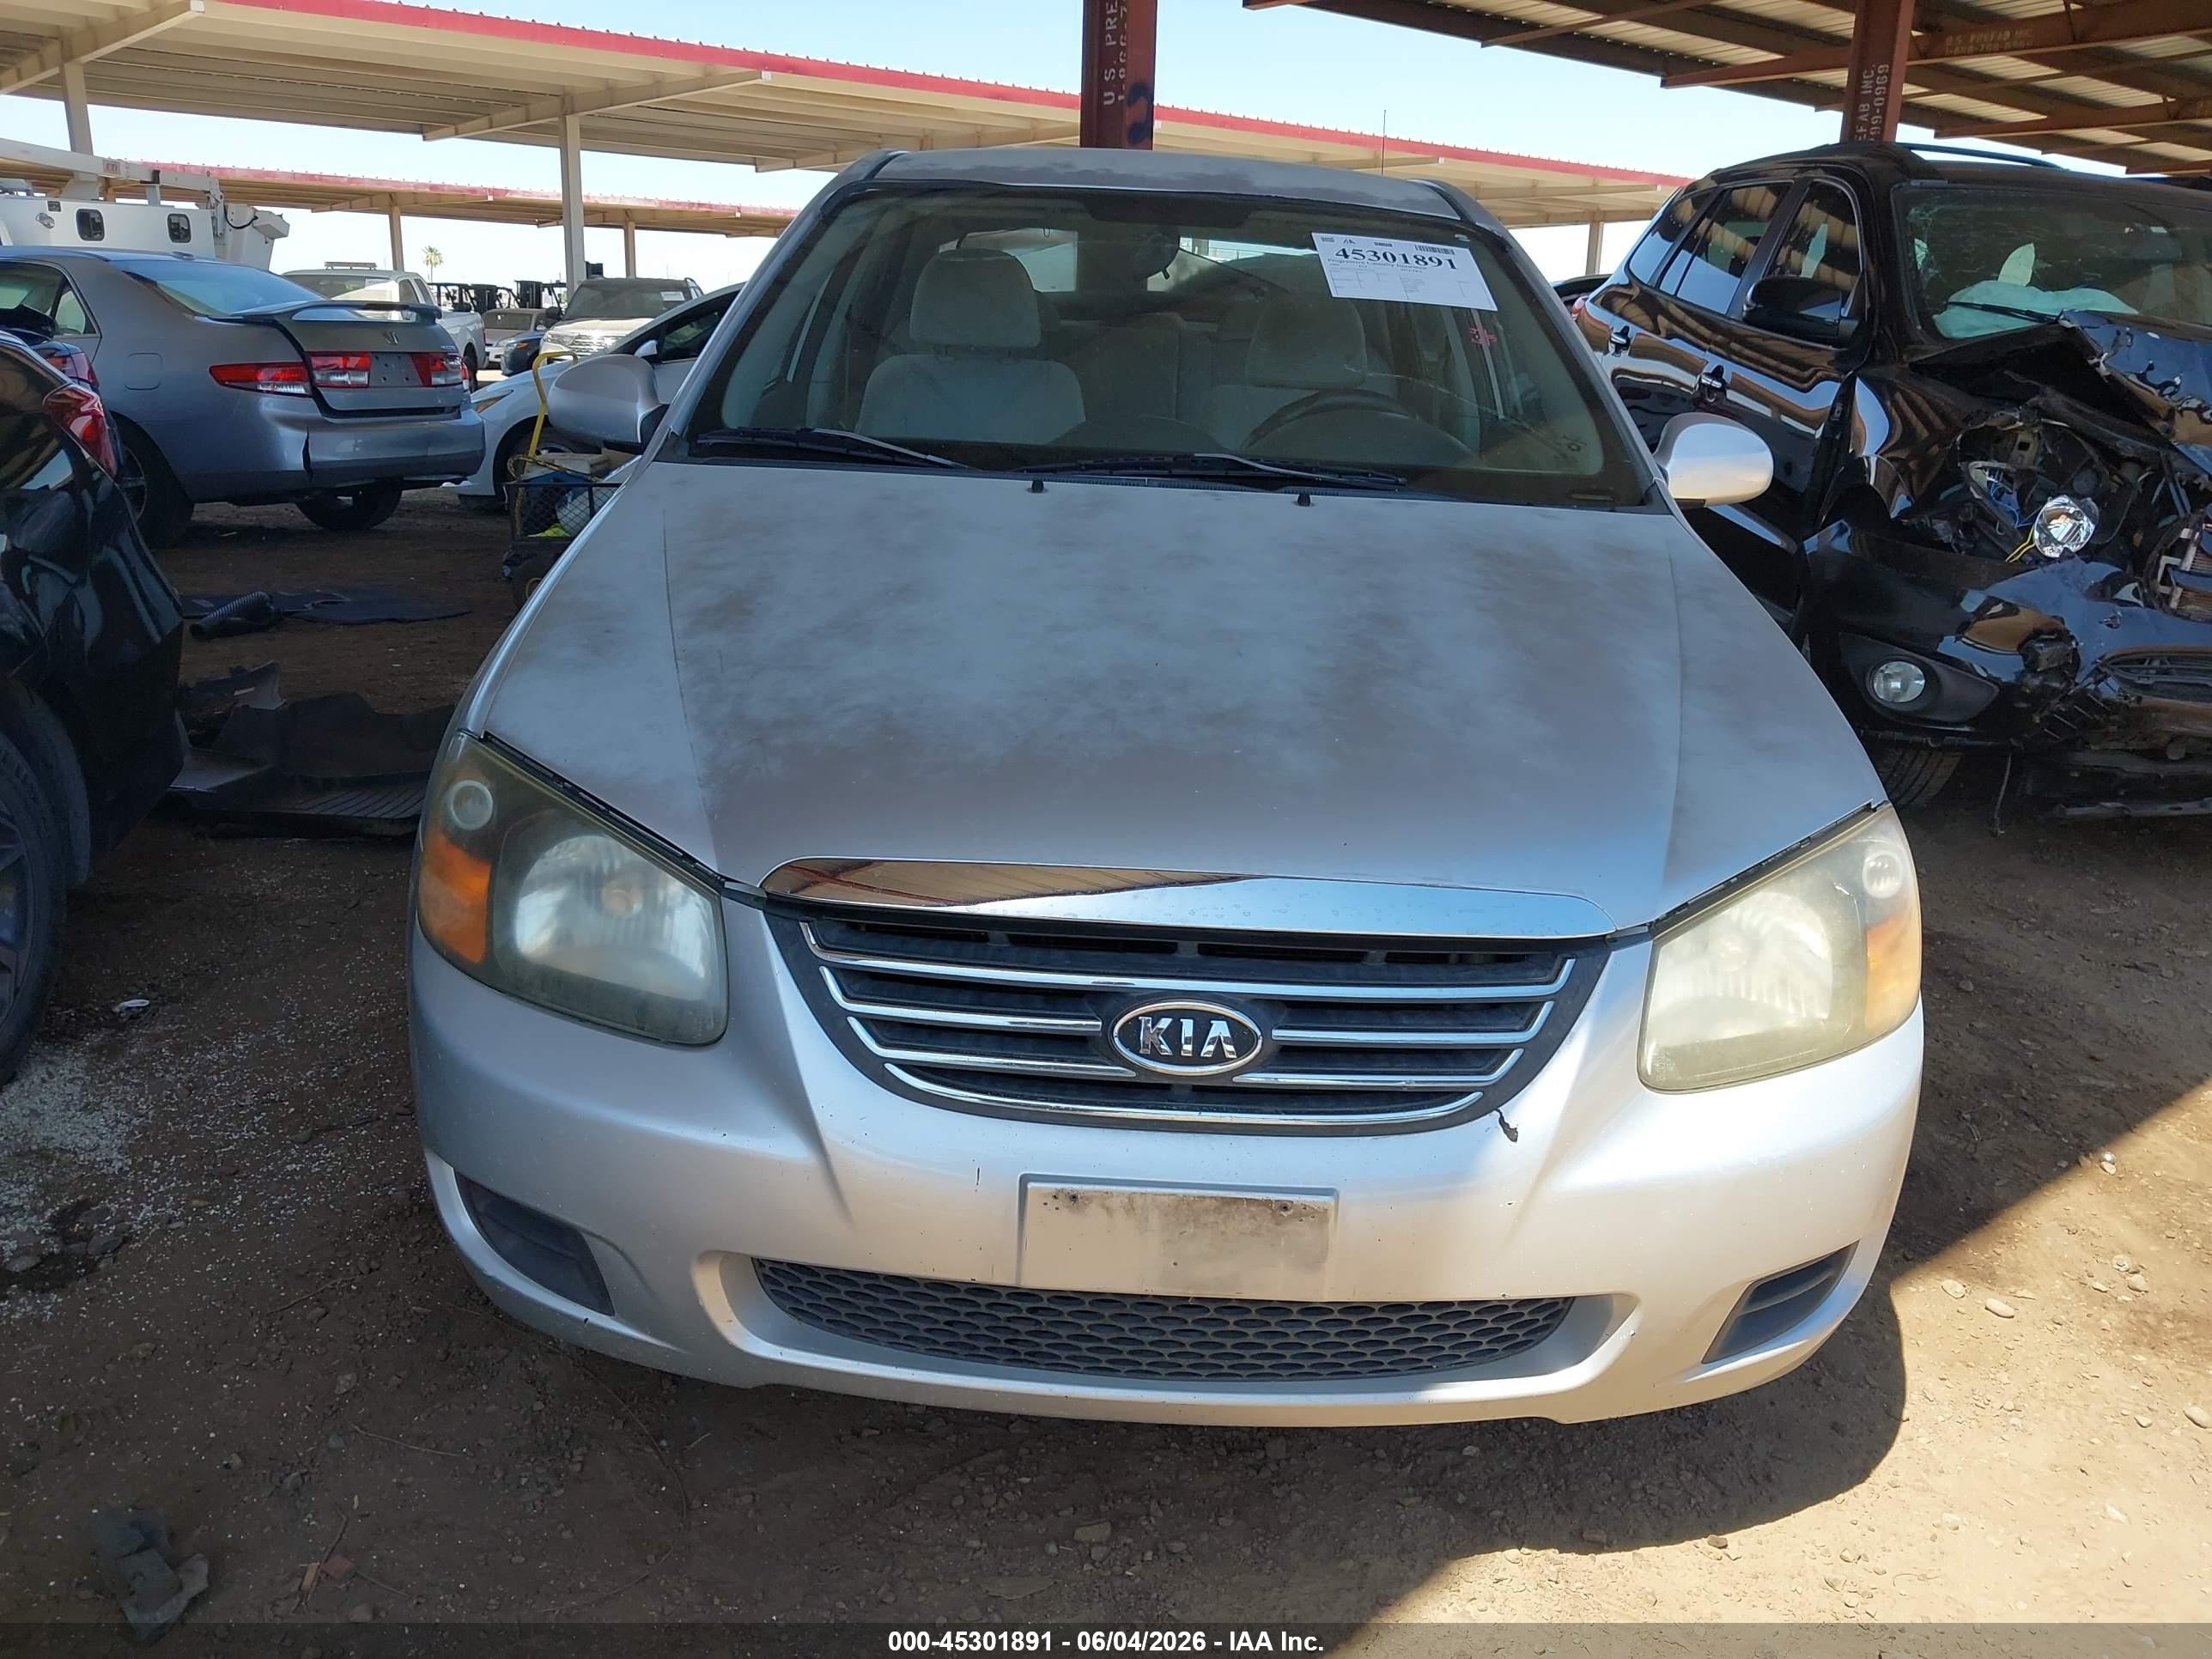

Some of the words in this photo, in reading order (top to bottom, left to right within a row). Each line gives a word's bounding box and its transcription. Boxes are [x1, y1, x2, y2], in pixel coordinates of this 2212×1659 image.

[1103, 60, 1116, 106] U.S.
[1860, 64, 1876, 94] INC.
[1335, 247, 1458, 270] 45301891
[1139, 1016, 1237, 1059] KIA
